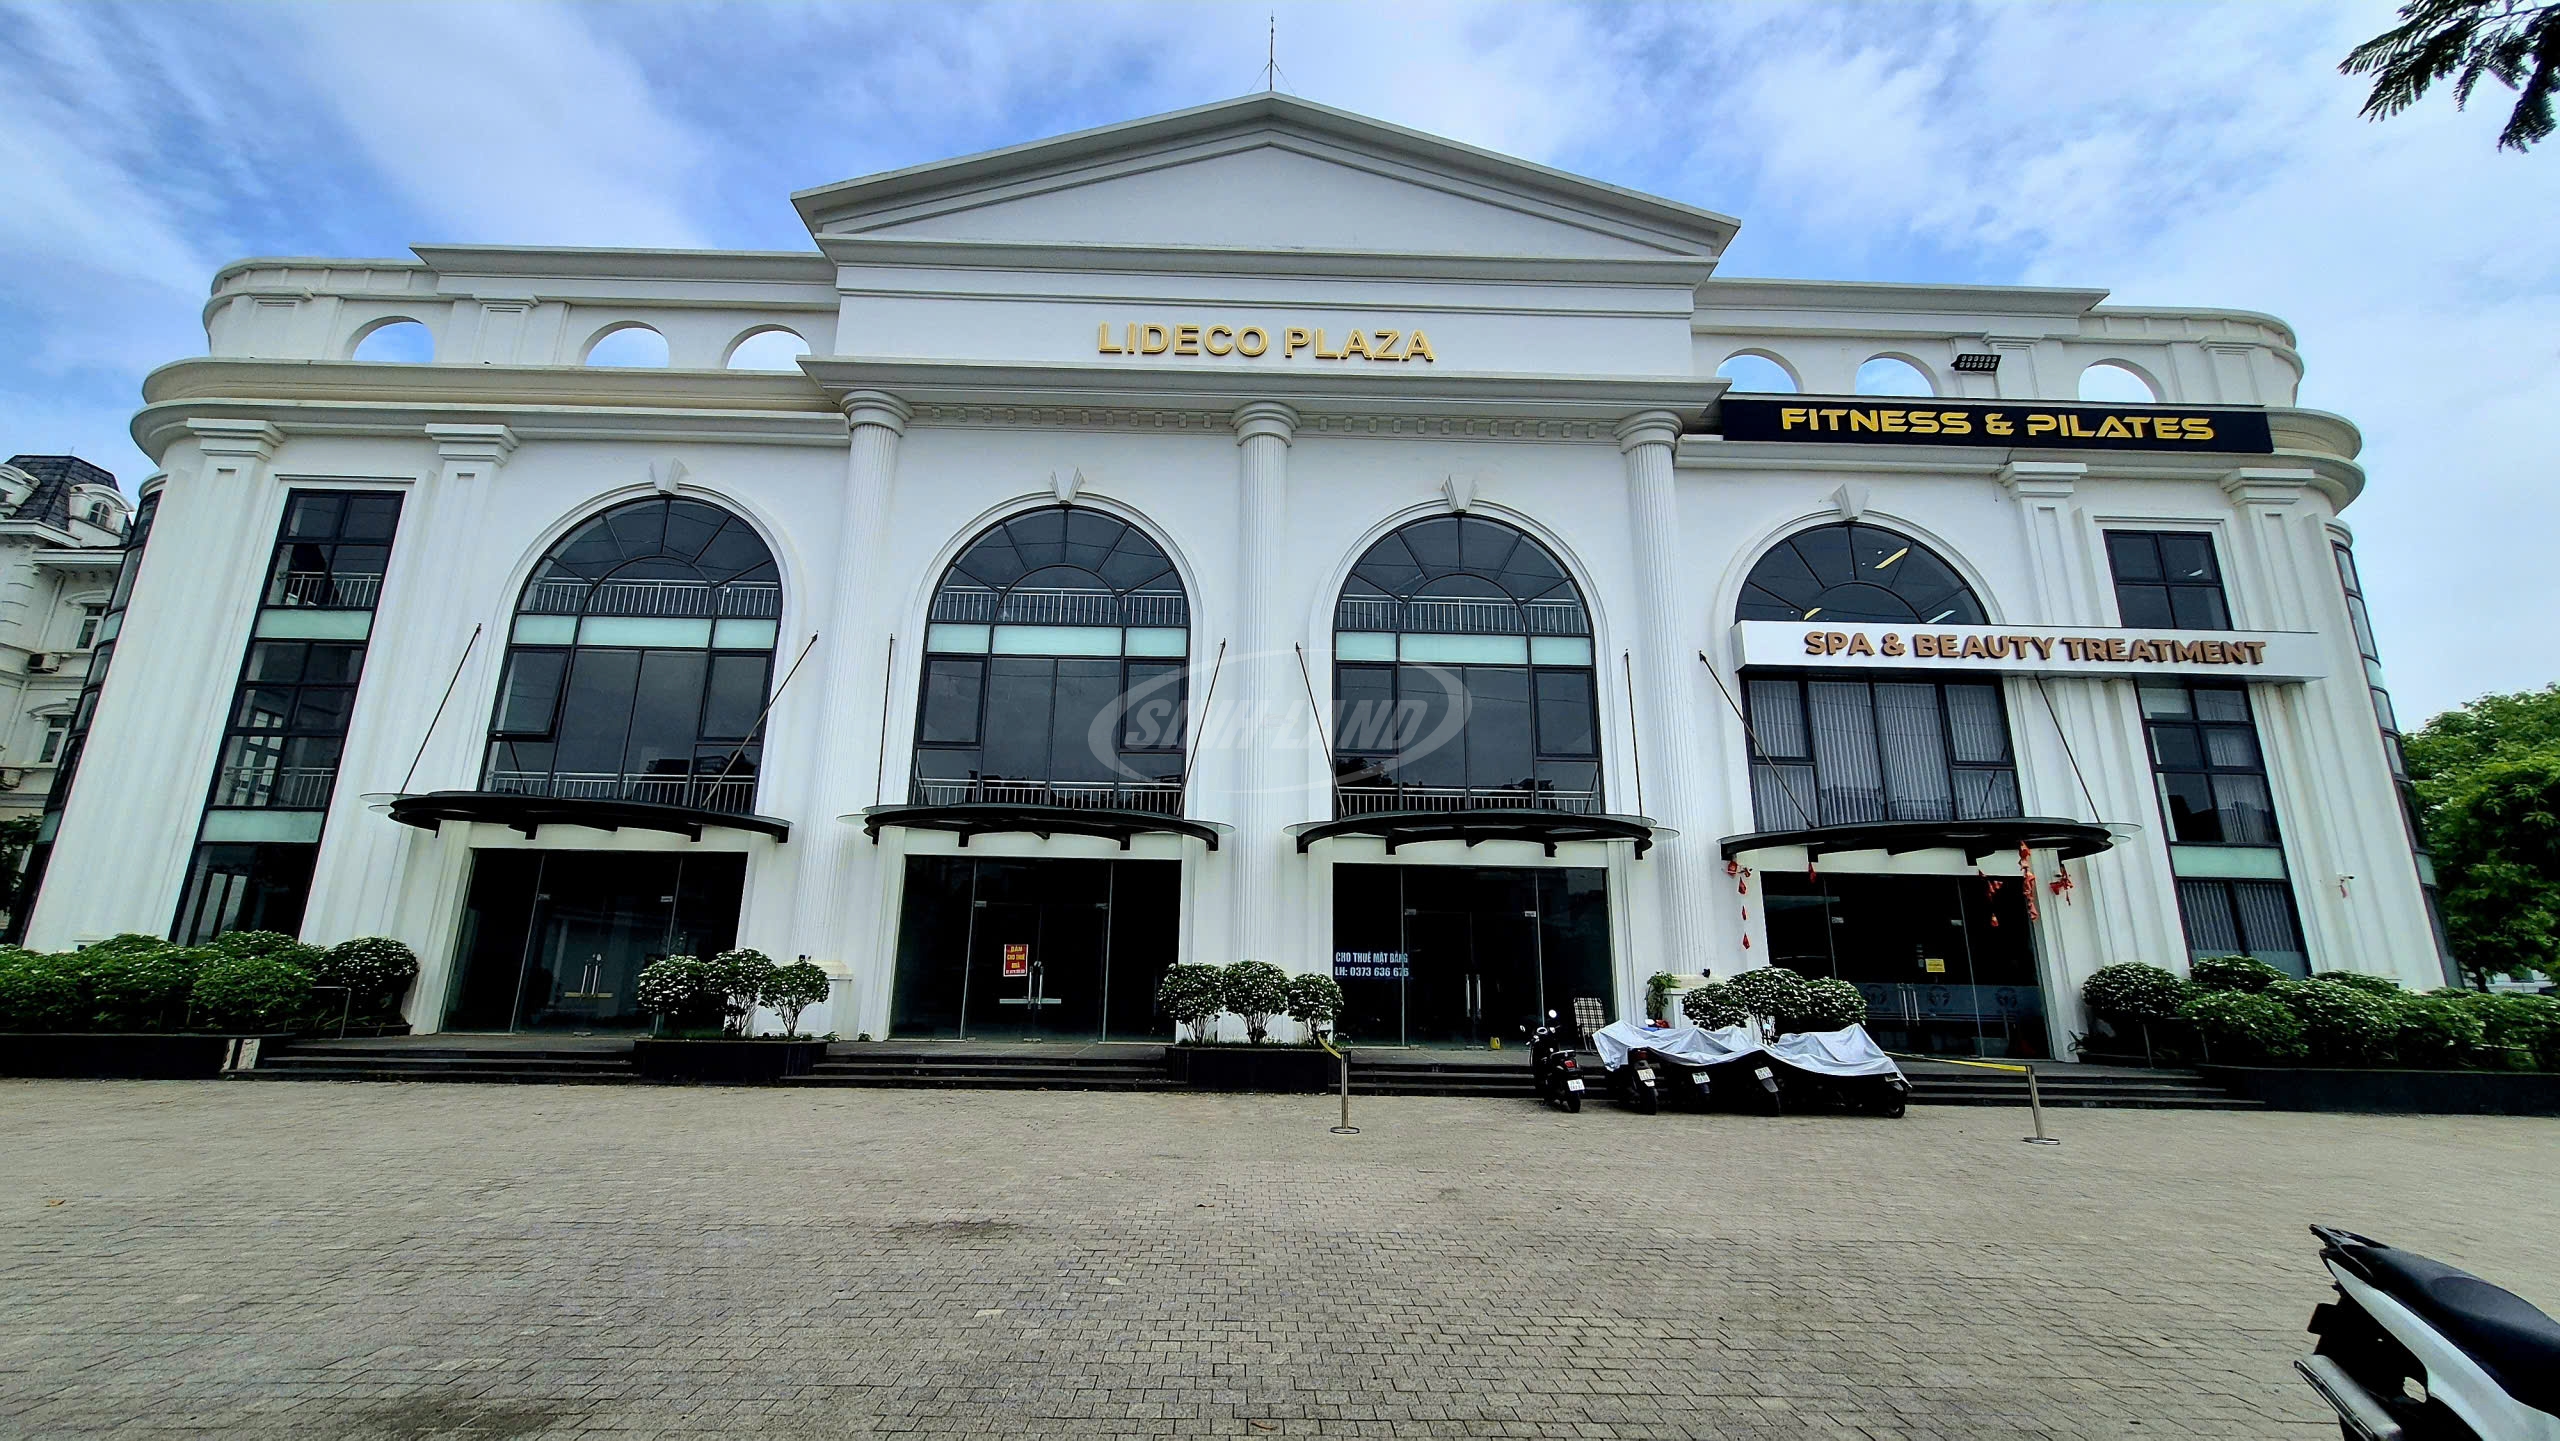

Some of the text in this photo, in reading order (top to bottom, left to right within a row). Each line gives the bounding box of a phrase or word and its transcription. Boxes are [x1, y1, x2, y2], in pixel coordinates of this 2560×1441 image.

[1099, 323, 1434, 361] LIDECO PLAZA
[1781, 408, 2214, 440] FITNESS & PILATES
[1804, 631, 2266, 665] SPA & BEAUTY TREATMENT
[1334, 966, 1347, 976] LH:
[1350, 967, 1371, 977] 0373
[1374, 967, 1390, 977] 636
[1335, 951, 1351, 962] CHO
